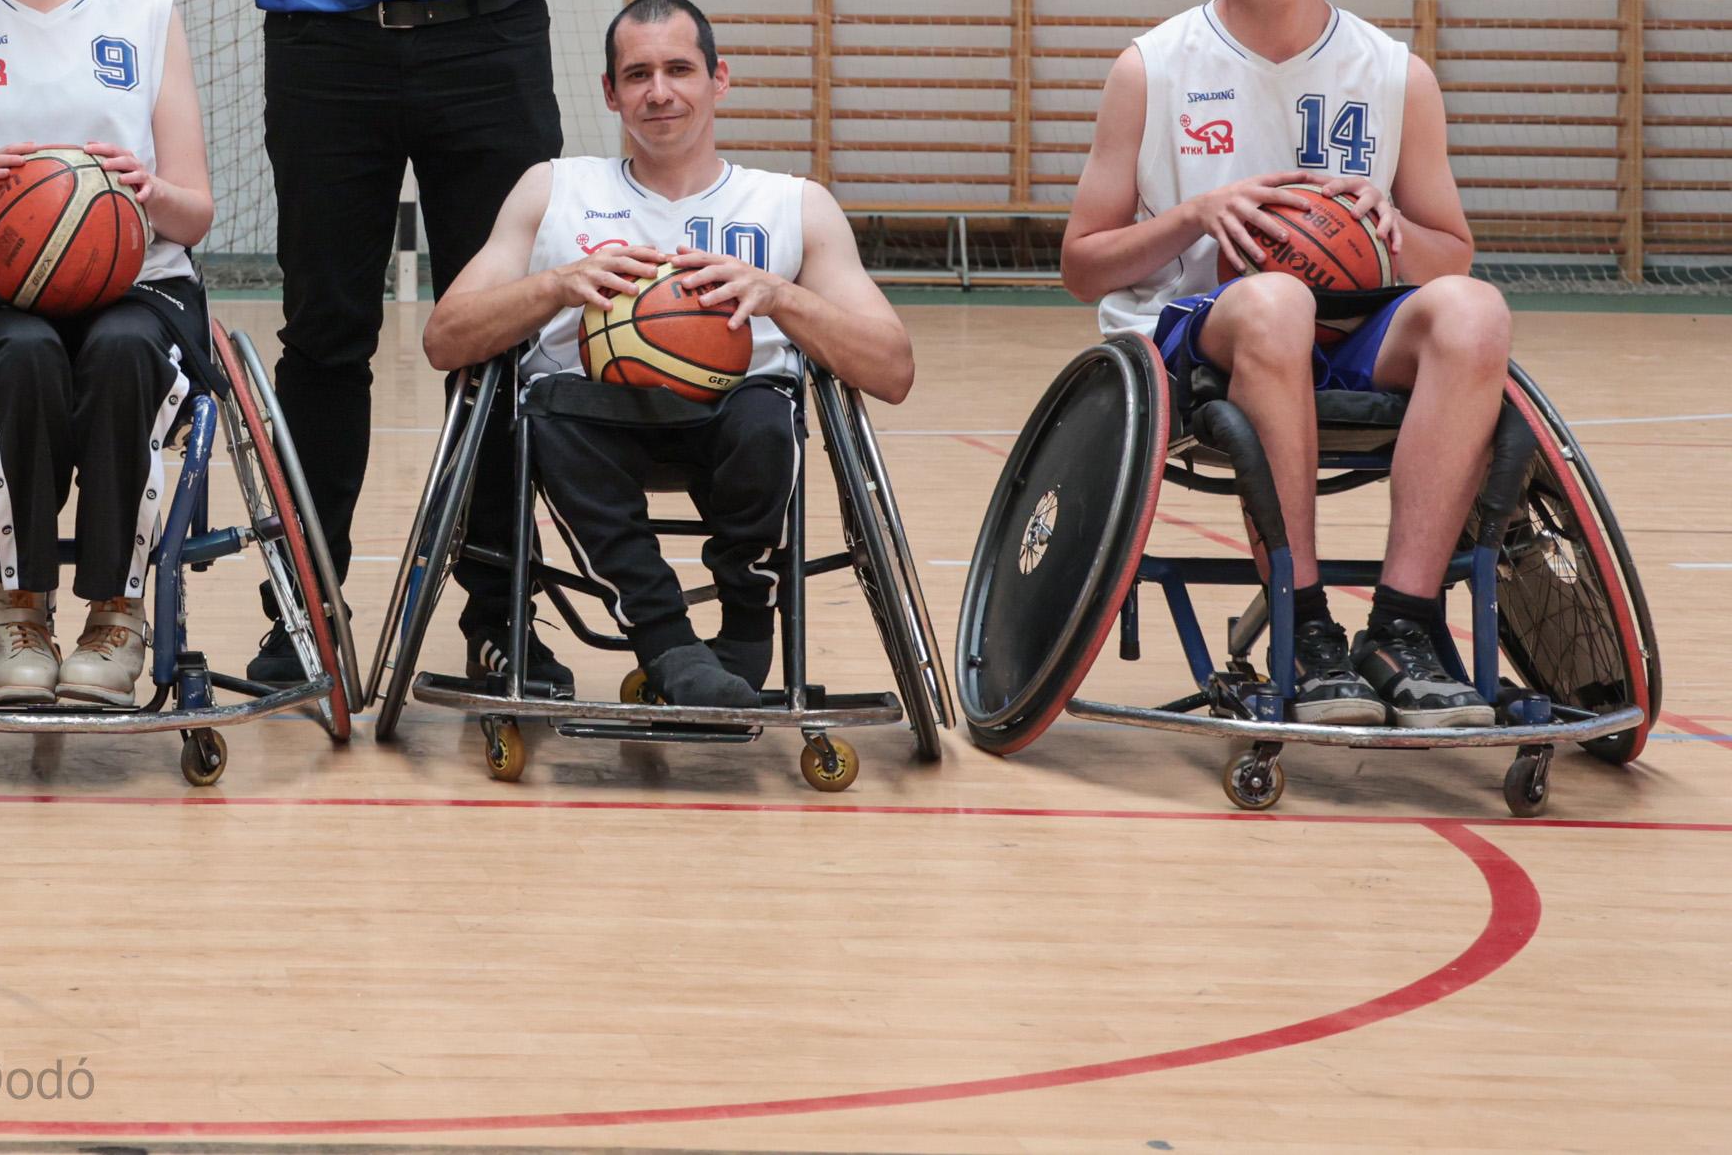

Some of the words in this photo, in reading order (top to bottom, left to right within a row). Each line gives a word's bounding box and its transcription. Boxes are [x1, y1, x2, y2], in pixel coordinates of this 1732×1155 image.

[91, 35, 139, 92] 9
[1186, 88, 1235, 104] SPALDING
[1296, 93, 1376, 177] 14
[1180, 145, 1204, 156] NYKK
[584, 208, 632, 220] SPALDING
[684, 215, 770, 273] 10
[708, 375, 731, 387] GE7
